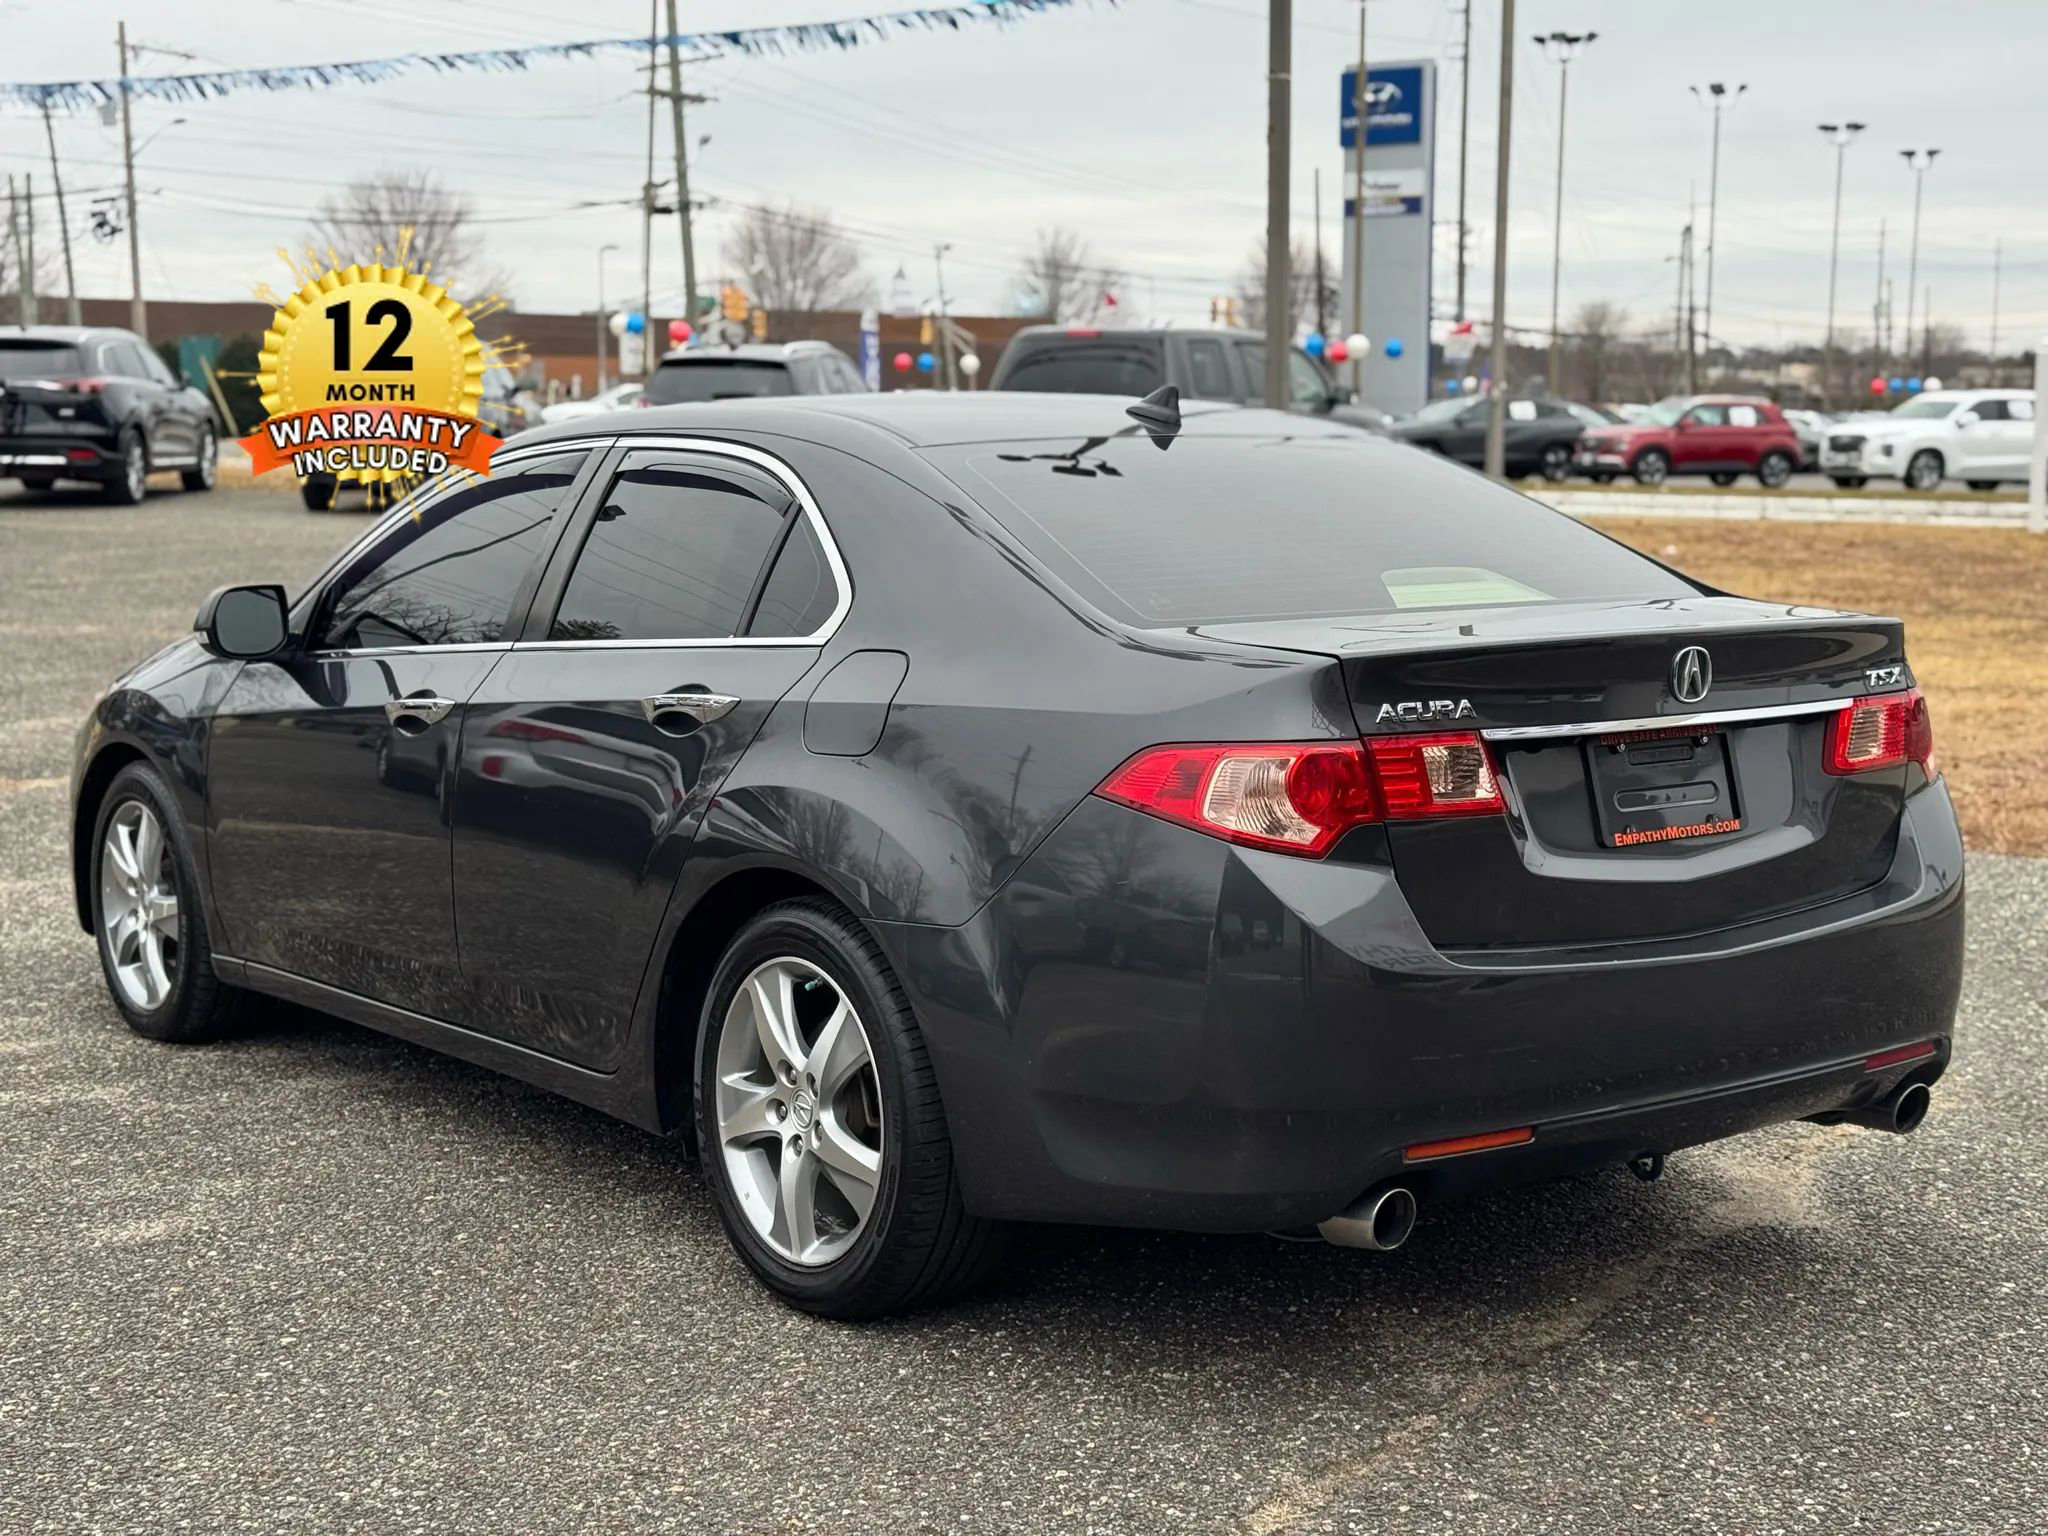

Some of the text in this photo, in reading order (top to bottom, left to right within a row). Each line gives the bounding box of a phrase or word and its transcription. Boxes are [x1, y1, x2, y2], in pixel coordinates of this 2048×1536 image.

[1866, 666, 1901, 686] TSX
[1375, 699, 1478, 723] ACURA
[1600, 733, 1631, 745] DRIVE
[1633, 731, 1658, 742] SAFE
[1614, 819, 1740, 847] EMPATHYMOTORS.COM
